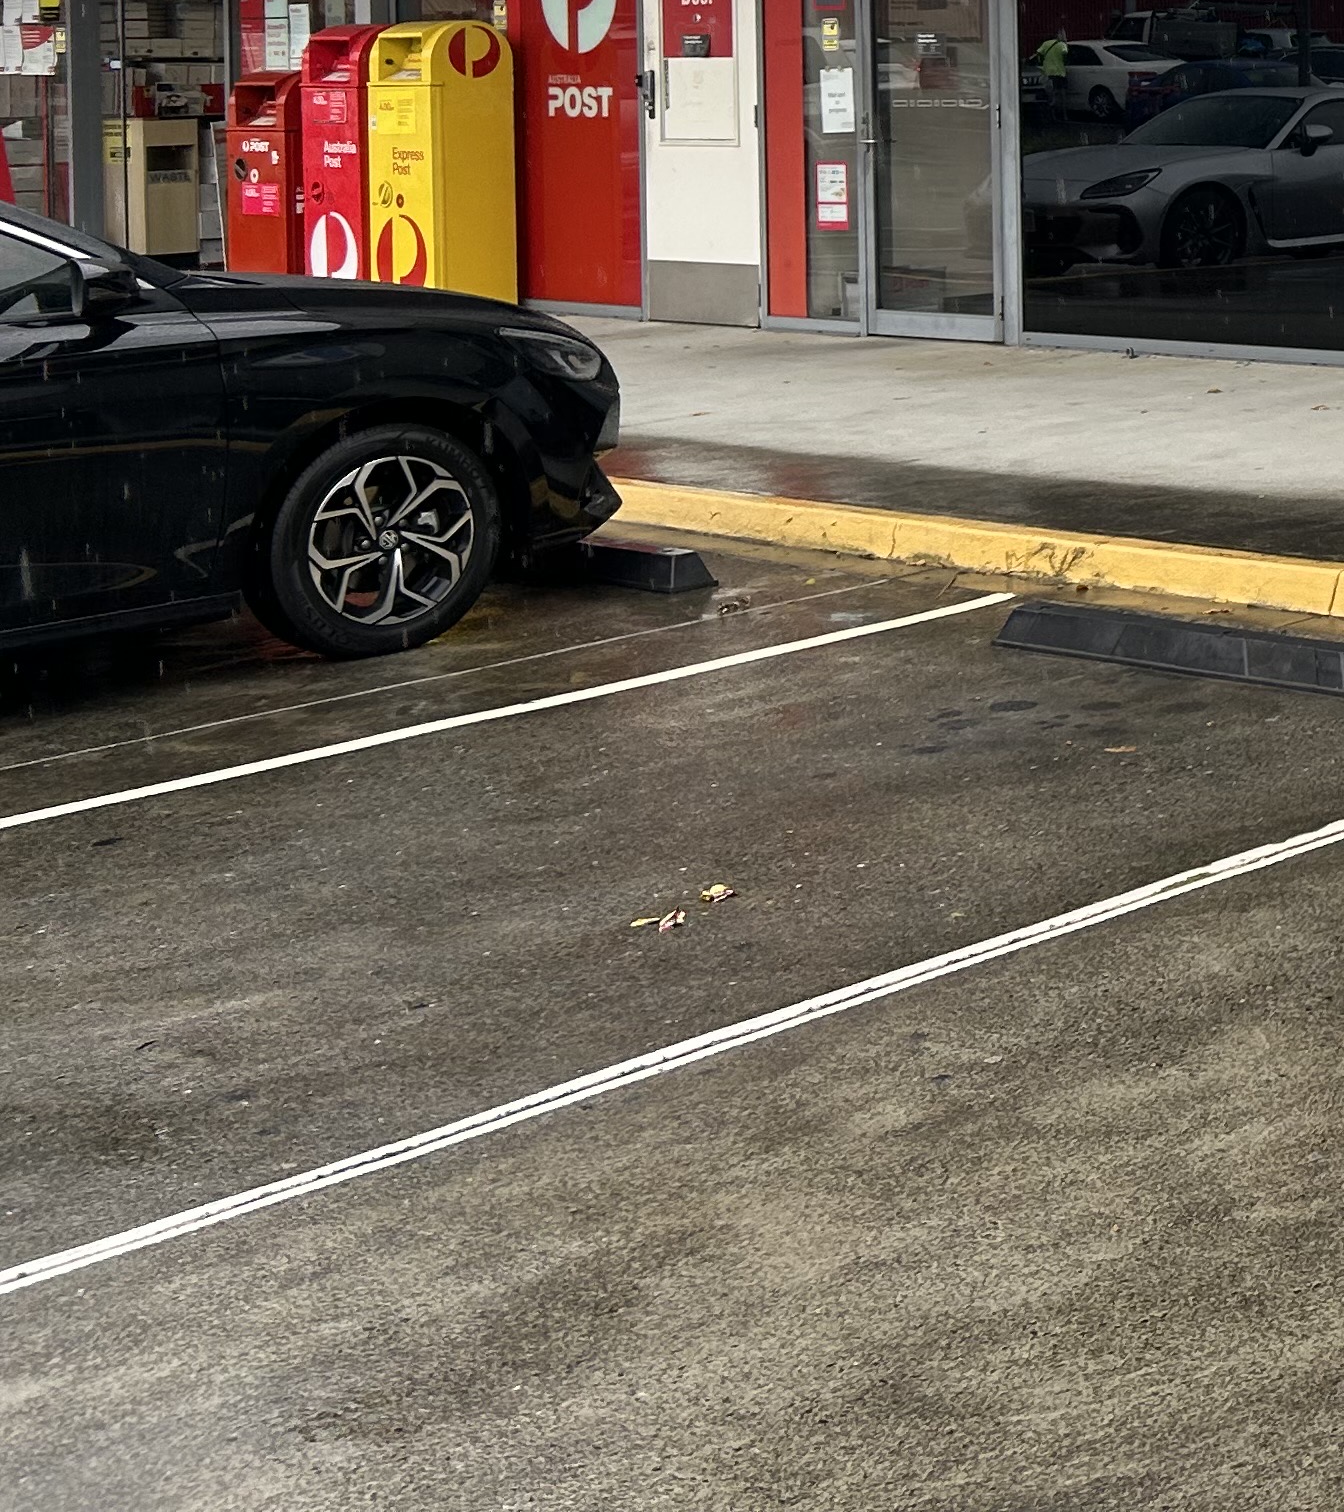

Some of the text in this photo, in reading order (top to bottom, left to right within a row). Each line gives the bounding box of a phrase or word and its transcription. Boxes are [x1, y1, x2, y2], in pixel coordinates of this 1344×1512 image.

[548, 86, 613, 118] POST
[249, 141, 270, 152] POST
[323, 140, 357, 154] Australia
[323, 155, 342, 168] Post
[392, 147, 424, 162] Express
[392, 162, 411, 176] Post
